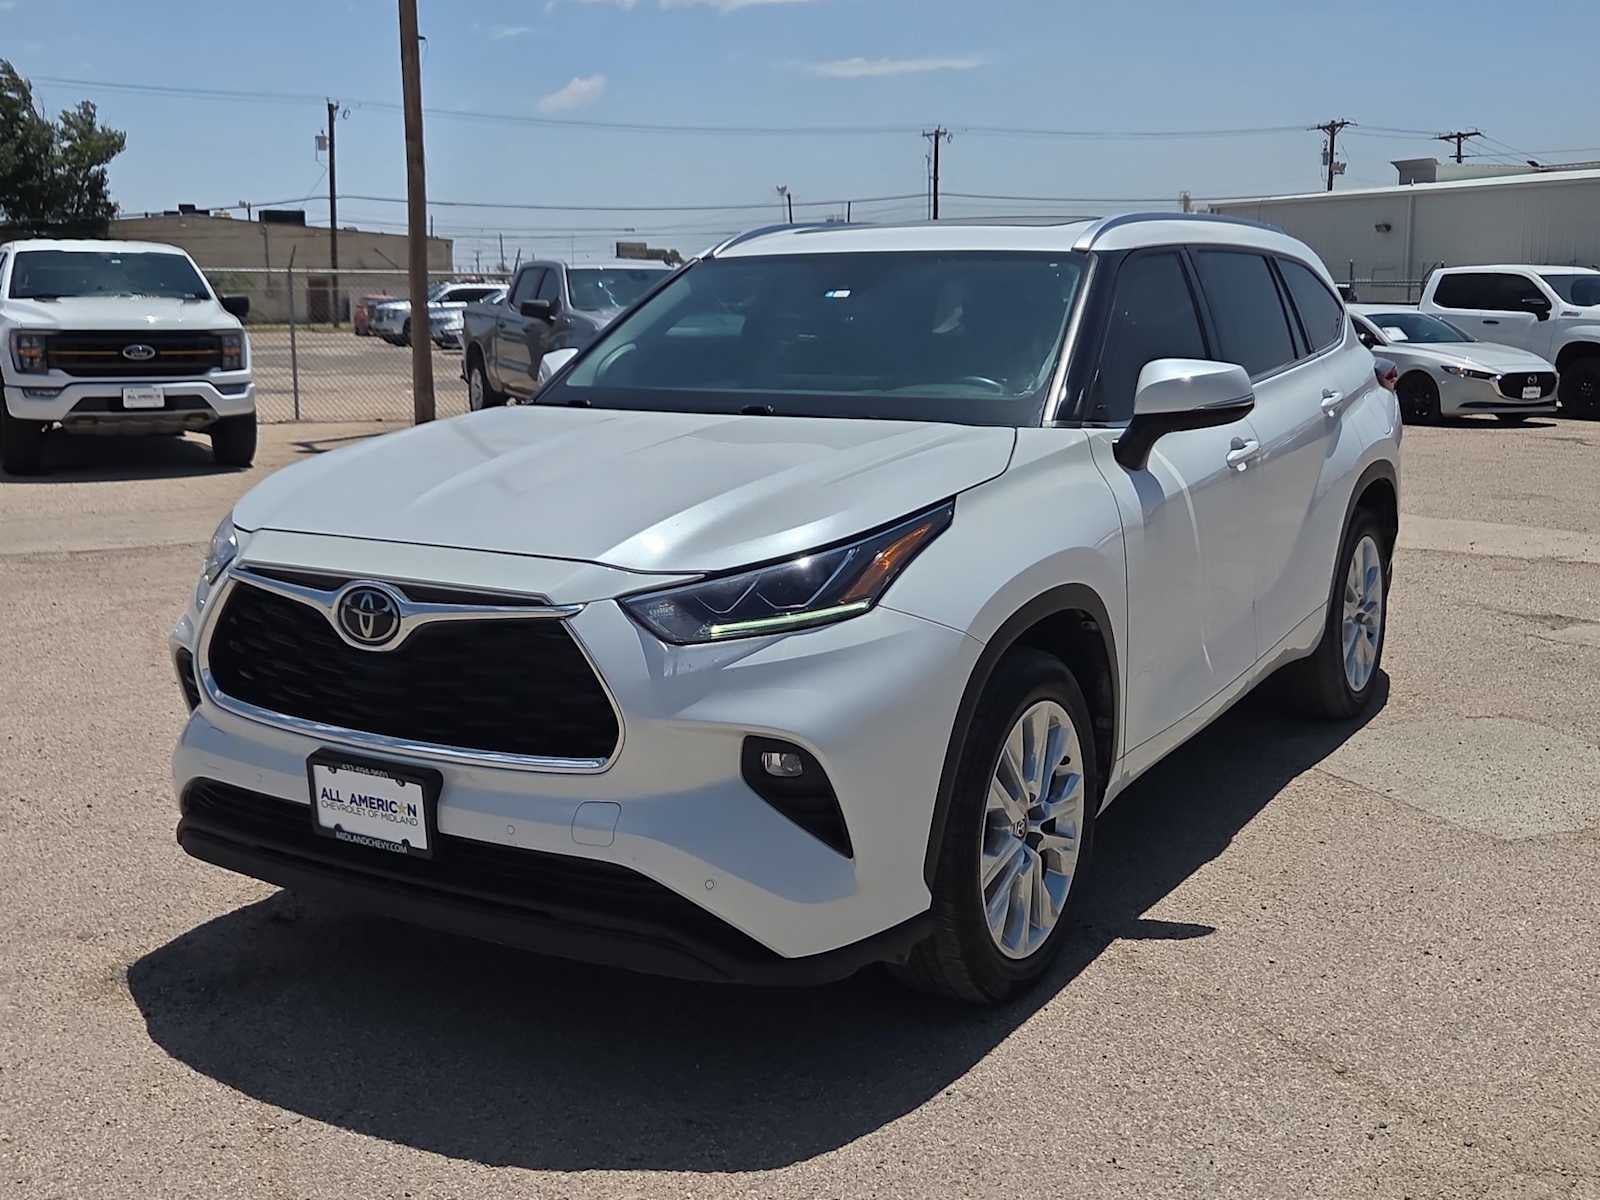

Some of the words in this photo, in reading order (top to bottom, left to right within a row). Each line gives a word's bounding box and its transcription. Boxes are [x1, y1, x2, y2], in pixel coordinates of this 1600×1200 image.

[321, 787, 344, 803] ALL
[321, 800, 367, 816] CHEVROLET
[368, 810, 378, 820] OF
[381, 813, 419, 827] MIDLAND
